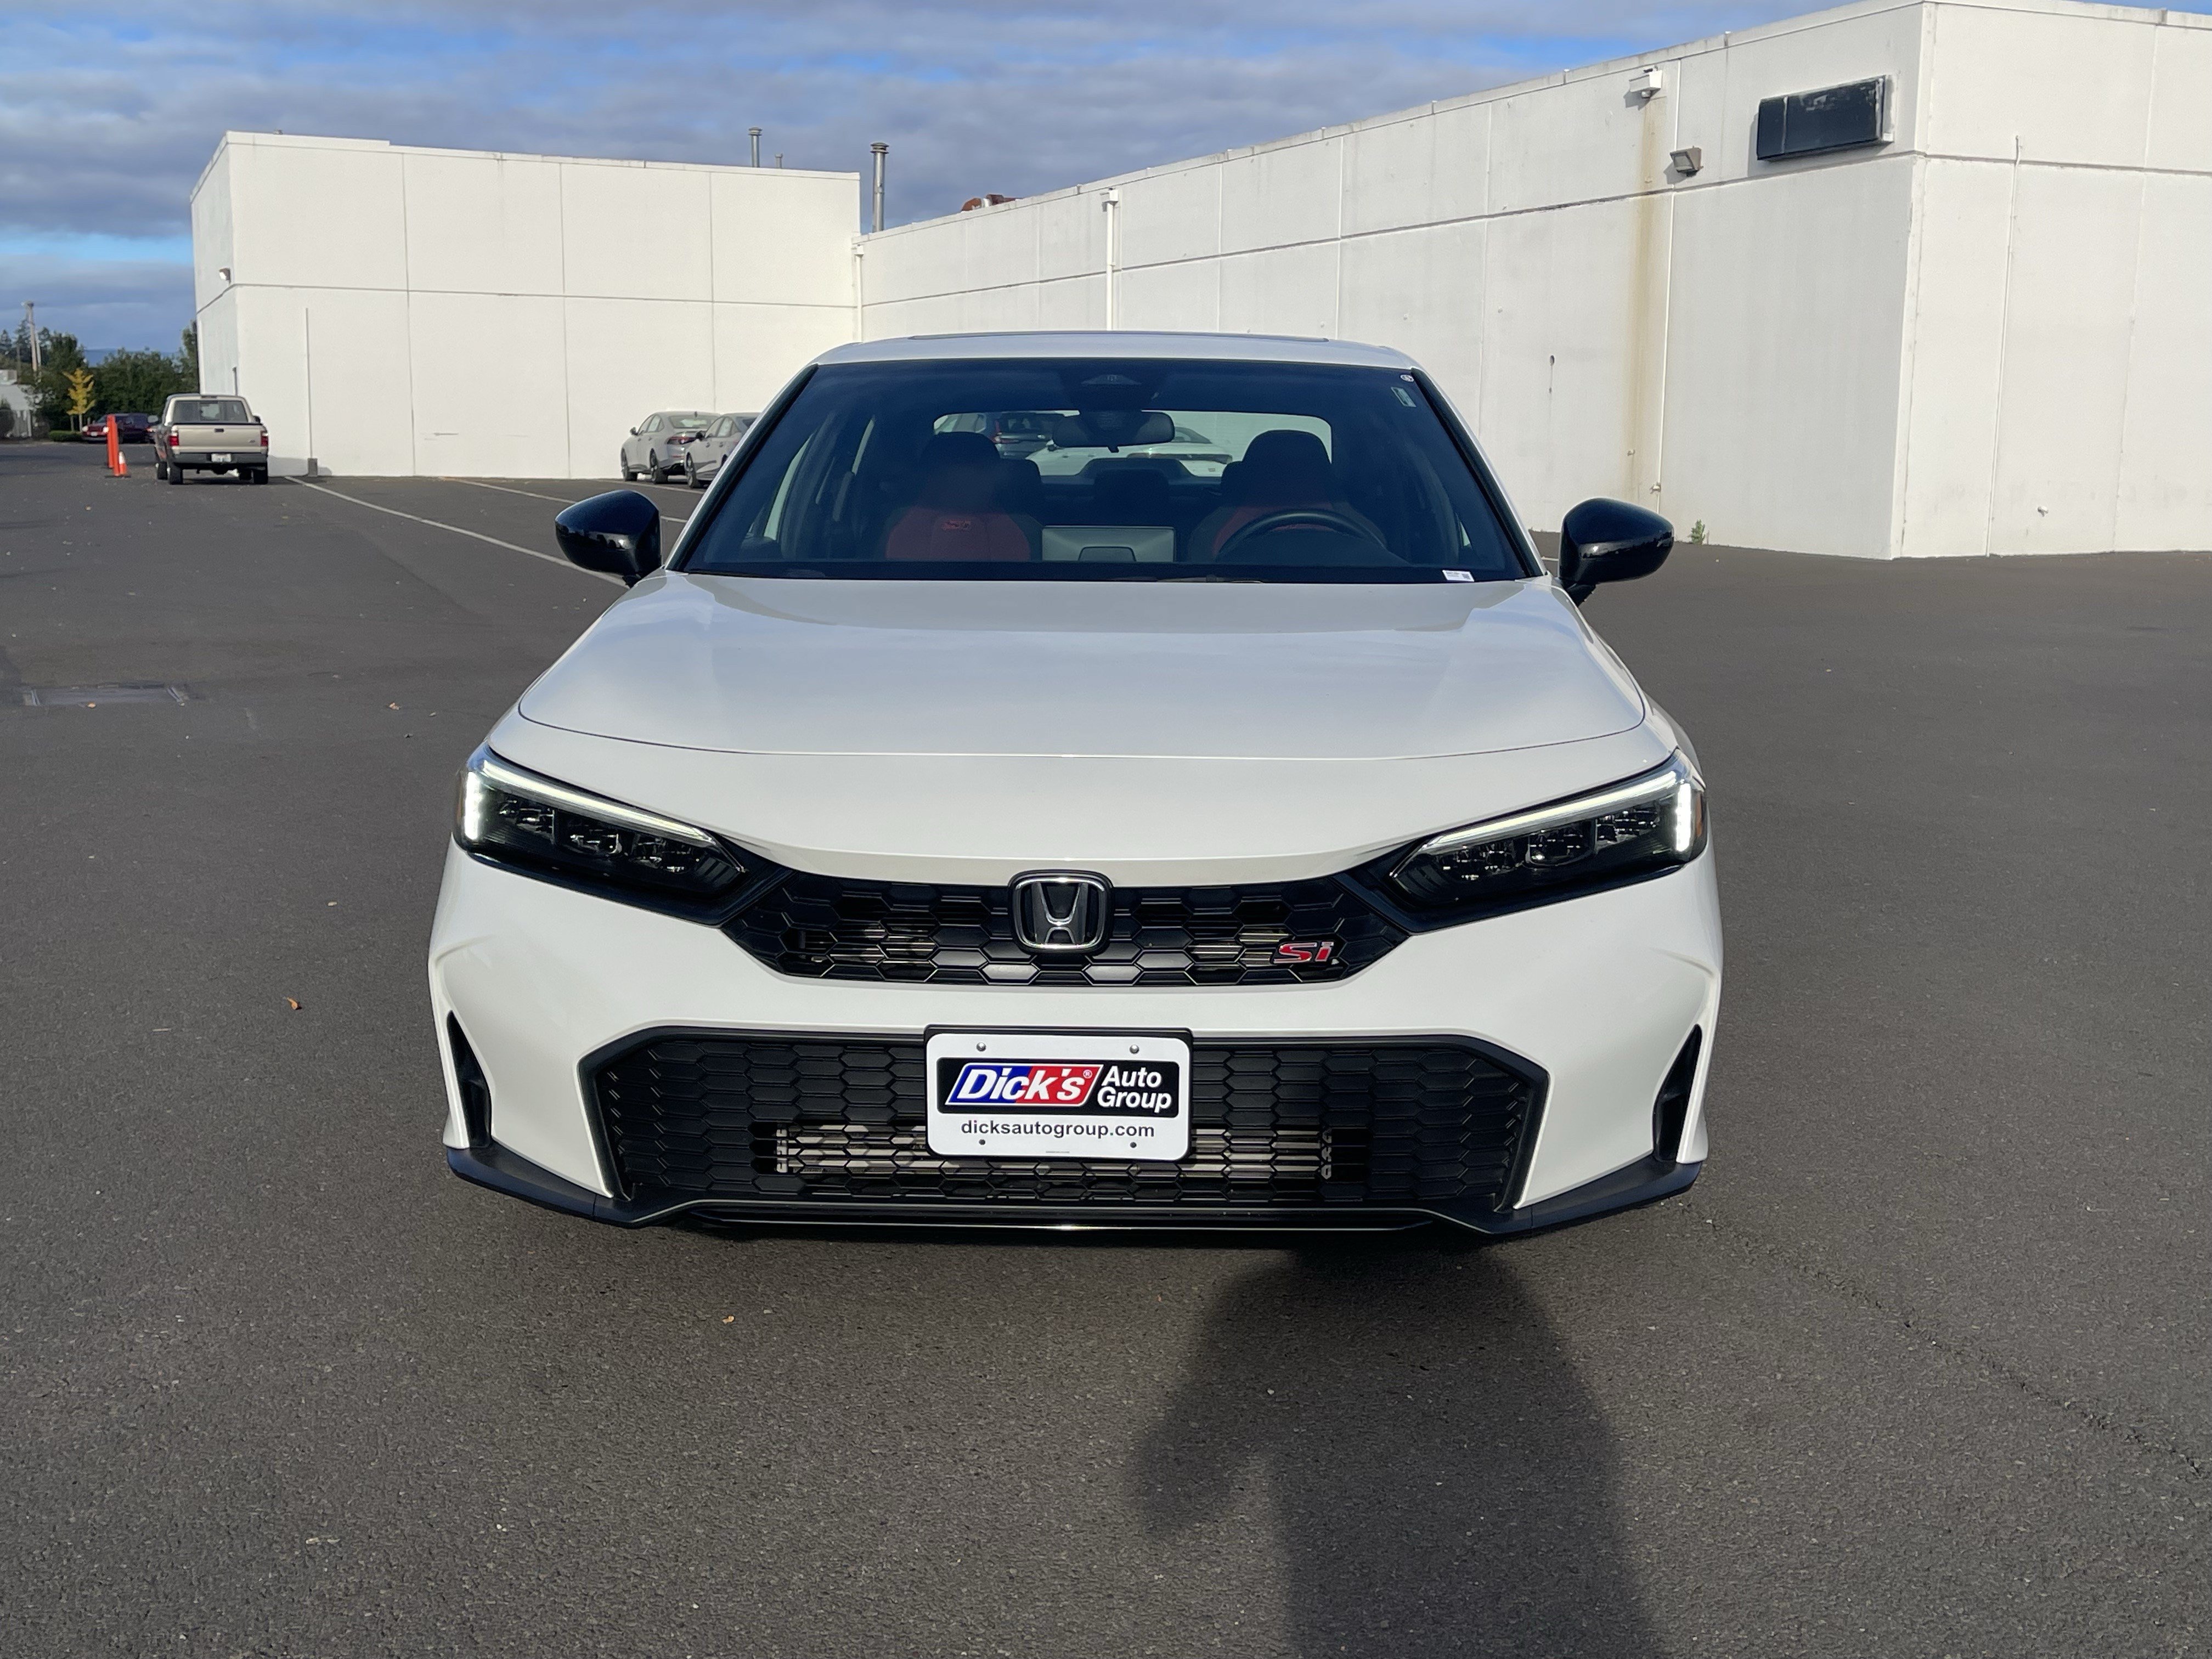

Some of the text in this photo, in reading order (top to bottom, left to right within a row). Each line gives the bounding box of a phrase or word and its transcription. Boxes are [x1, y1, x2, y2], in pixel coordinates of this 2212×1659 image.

[1273, 941, 1334, 964] Si
[957, 1068, 1085, 1101] Dick's
[1101, 1065, 1162, 1088] Auto
[1097, 1086, 1172, 1114] Group
[961, 1120, 1154, 1139] dicksautogroup.com
